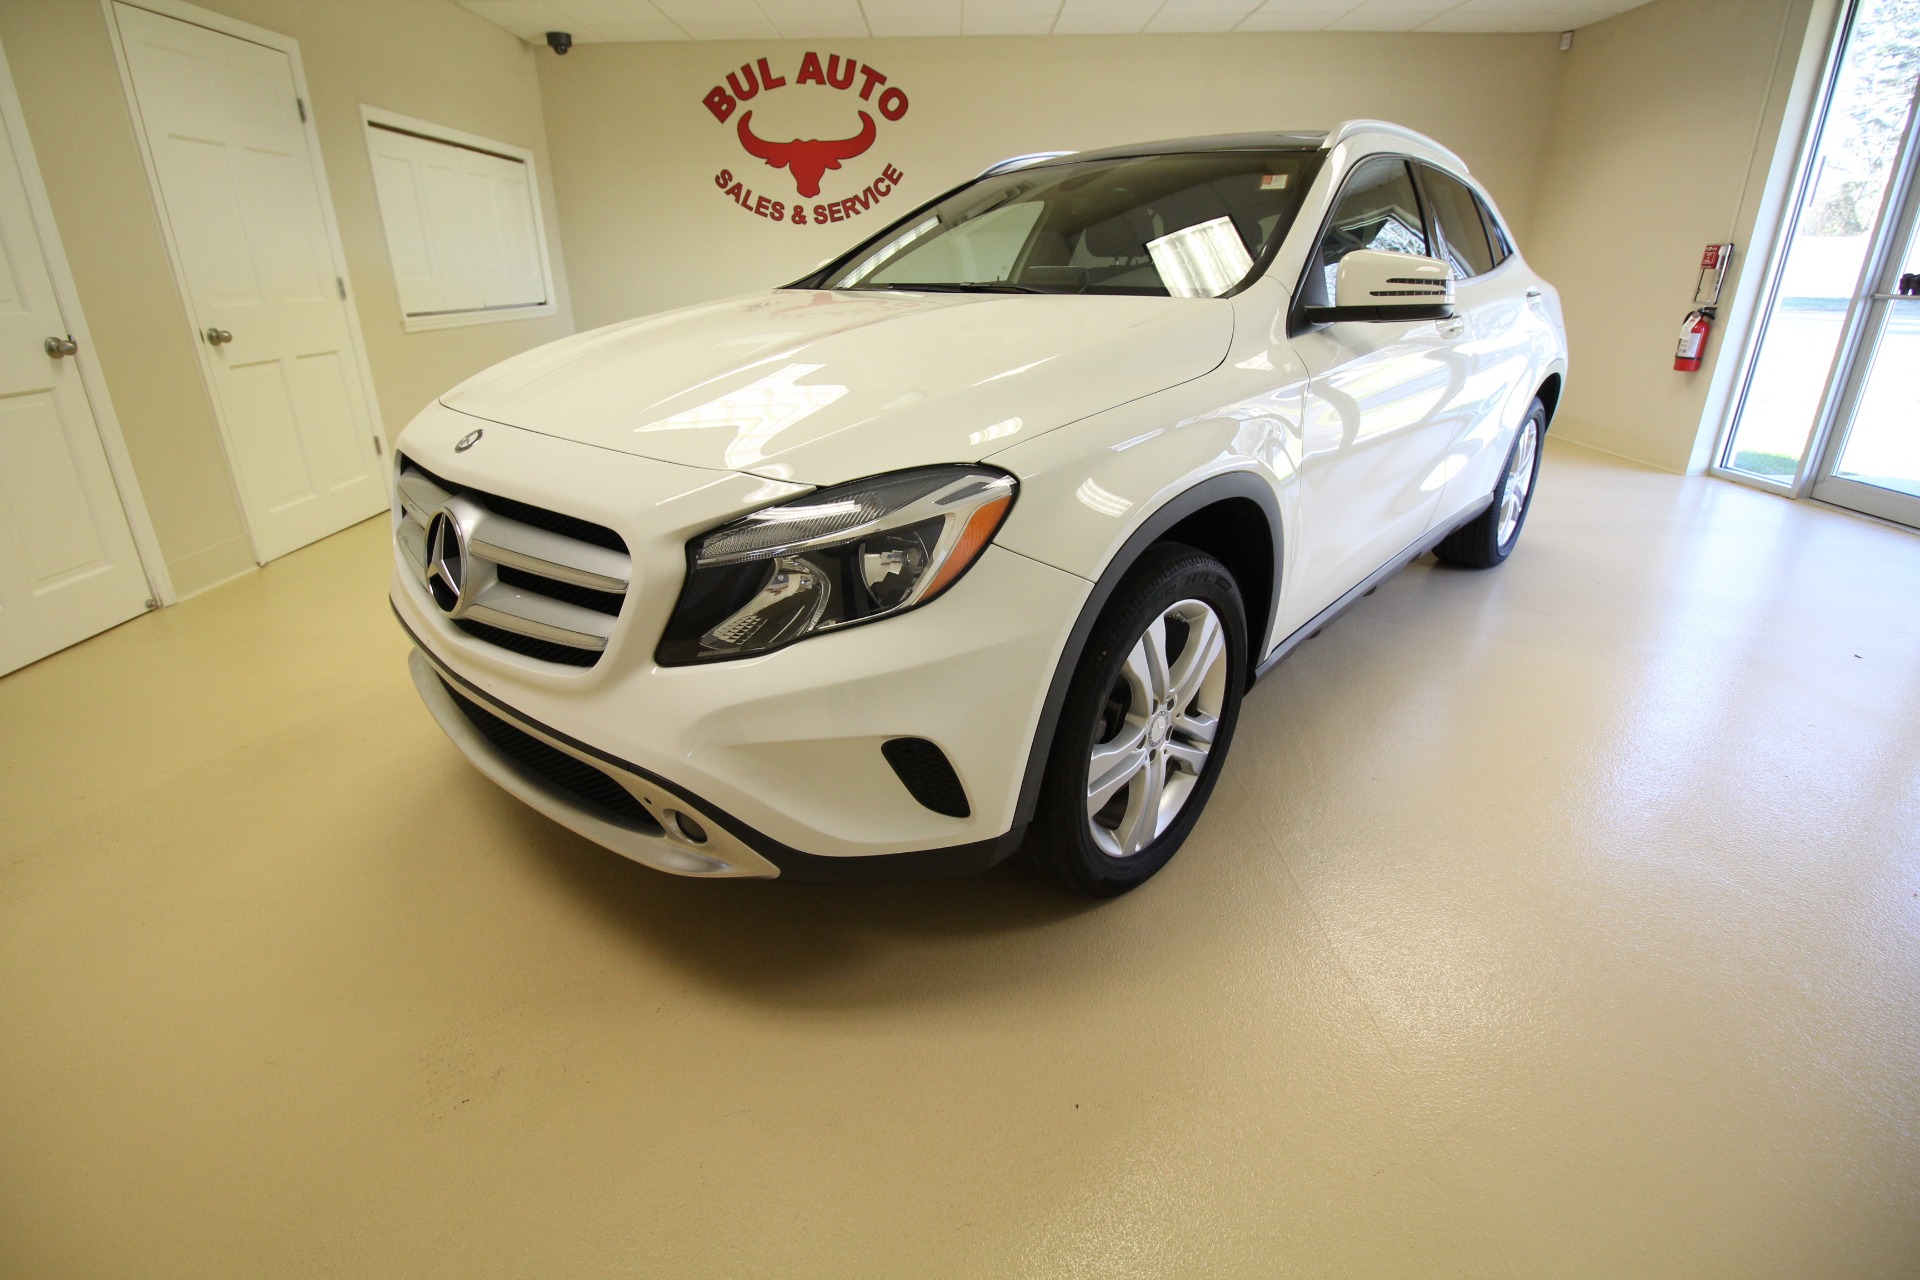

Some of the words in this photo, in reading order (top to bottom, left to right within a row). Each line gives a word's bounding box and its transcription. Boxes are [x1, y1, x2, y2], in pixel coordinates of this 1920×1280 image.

[702, 57, 787, 124] BUL
[796, 51, 909, 121] AUTO
[714, 169, 785, 222] SALES
[791, 204, 807, 225] &
[813, 163, 904, 225] SERVICE
